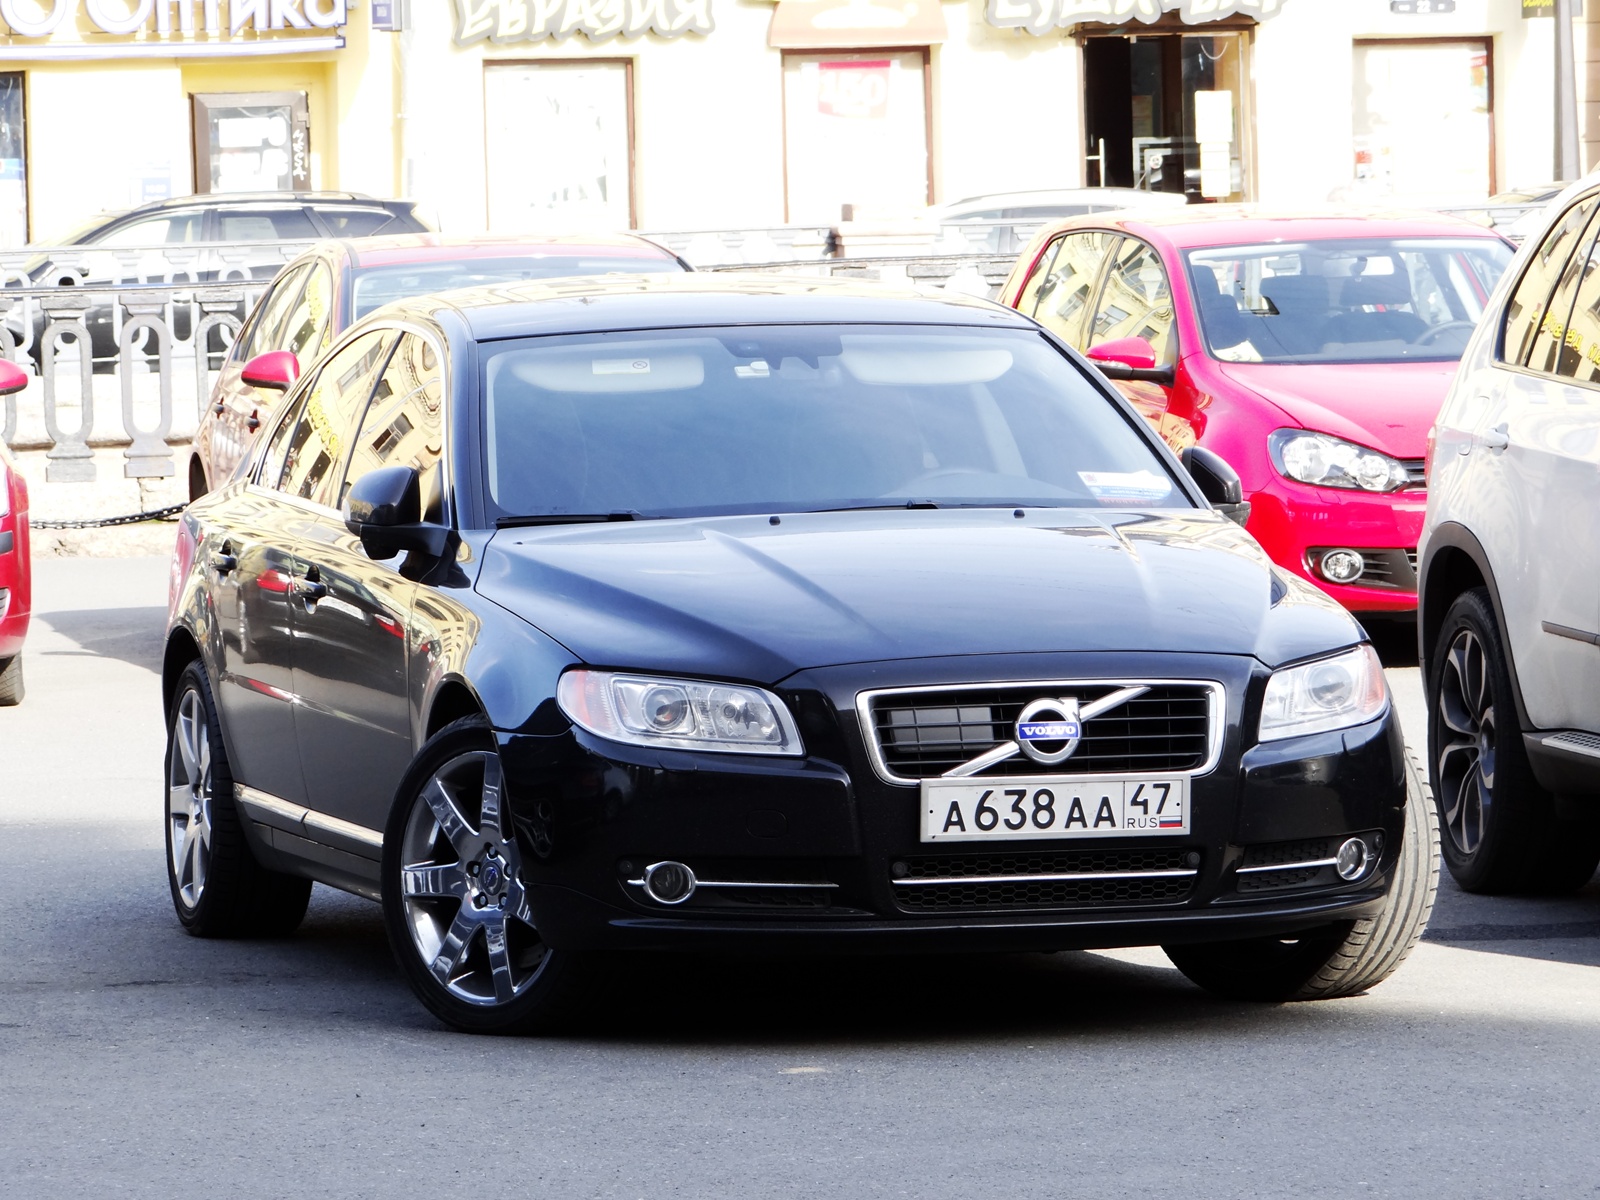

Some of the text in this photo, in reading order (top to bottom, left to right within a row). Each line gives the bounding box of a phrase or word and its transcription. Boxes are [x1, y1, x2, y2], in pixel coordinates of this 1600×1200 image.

[1021, 725, 1076, 736] VOLVO
[1130, 782, 1171, 815] 47
[1127, 817, 1158, 829] RUS
